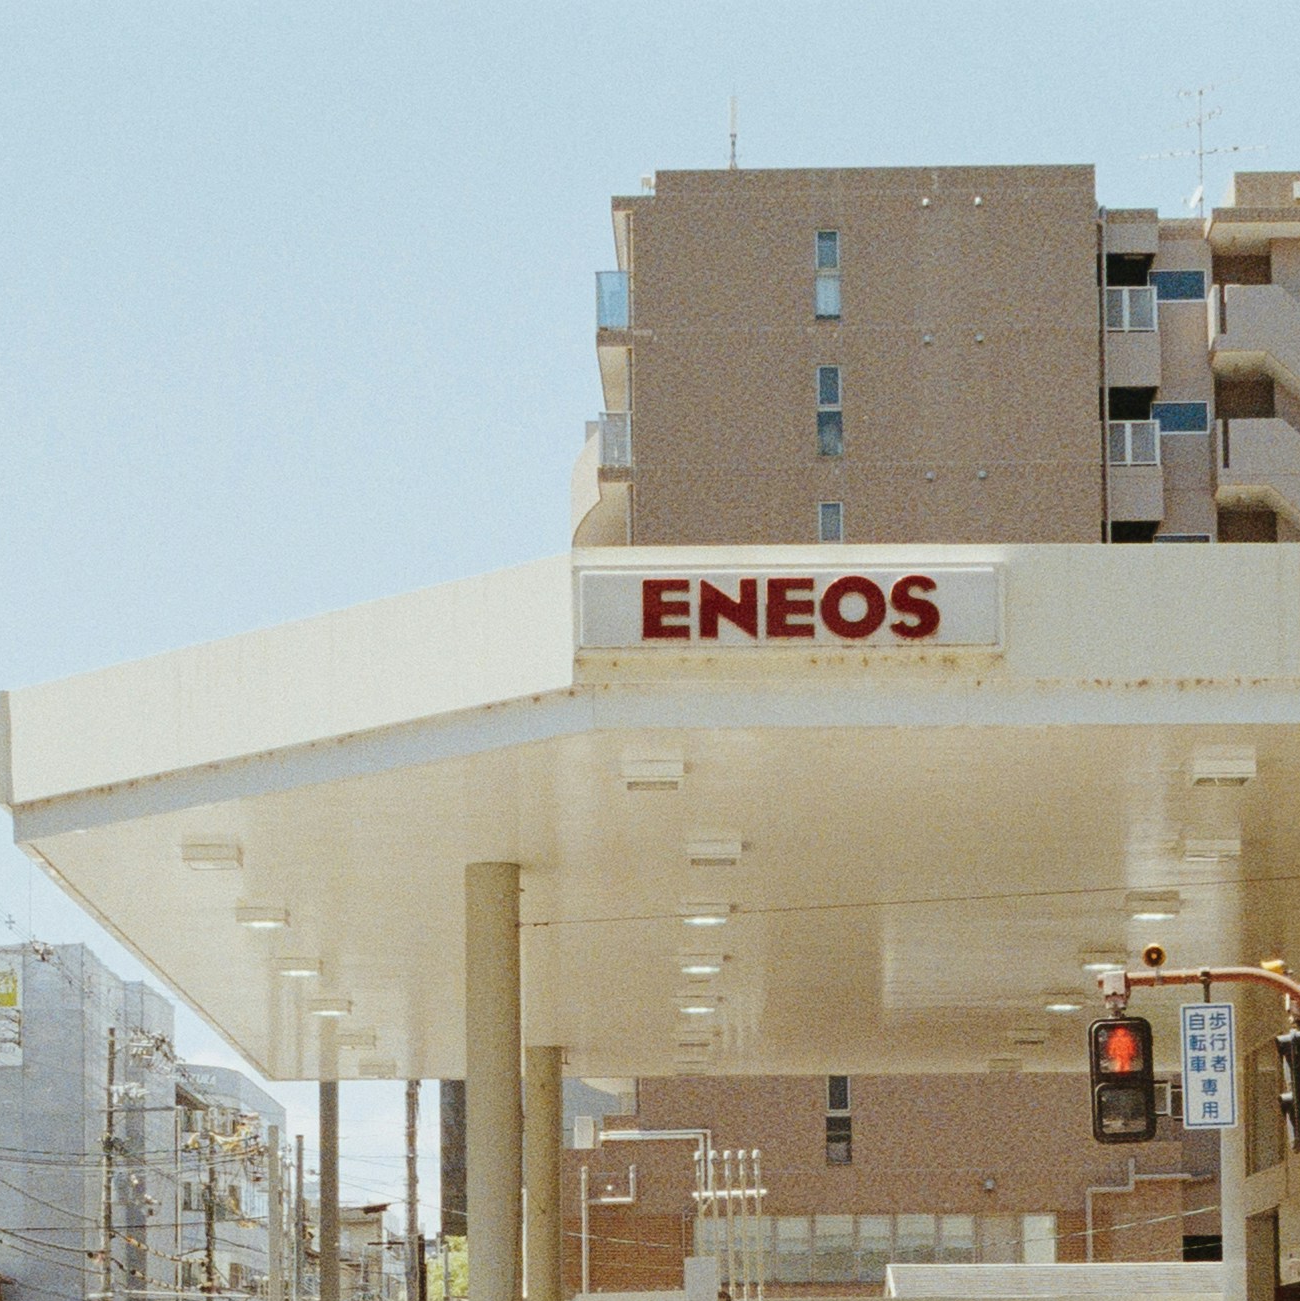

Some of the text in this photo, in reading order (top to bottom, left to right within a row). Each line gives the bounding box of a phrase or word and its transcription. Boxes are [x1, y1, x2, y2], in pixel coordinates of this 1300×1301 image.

[642, 575, 940, 639] ENEOS
[1188, 1012, 1207, 1073] 自転車
[1209, 1011, 1228, 1073] 歩行者
[1201, 1078, 1219, 1119] 専用
